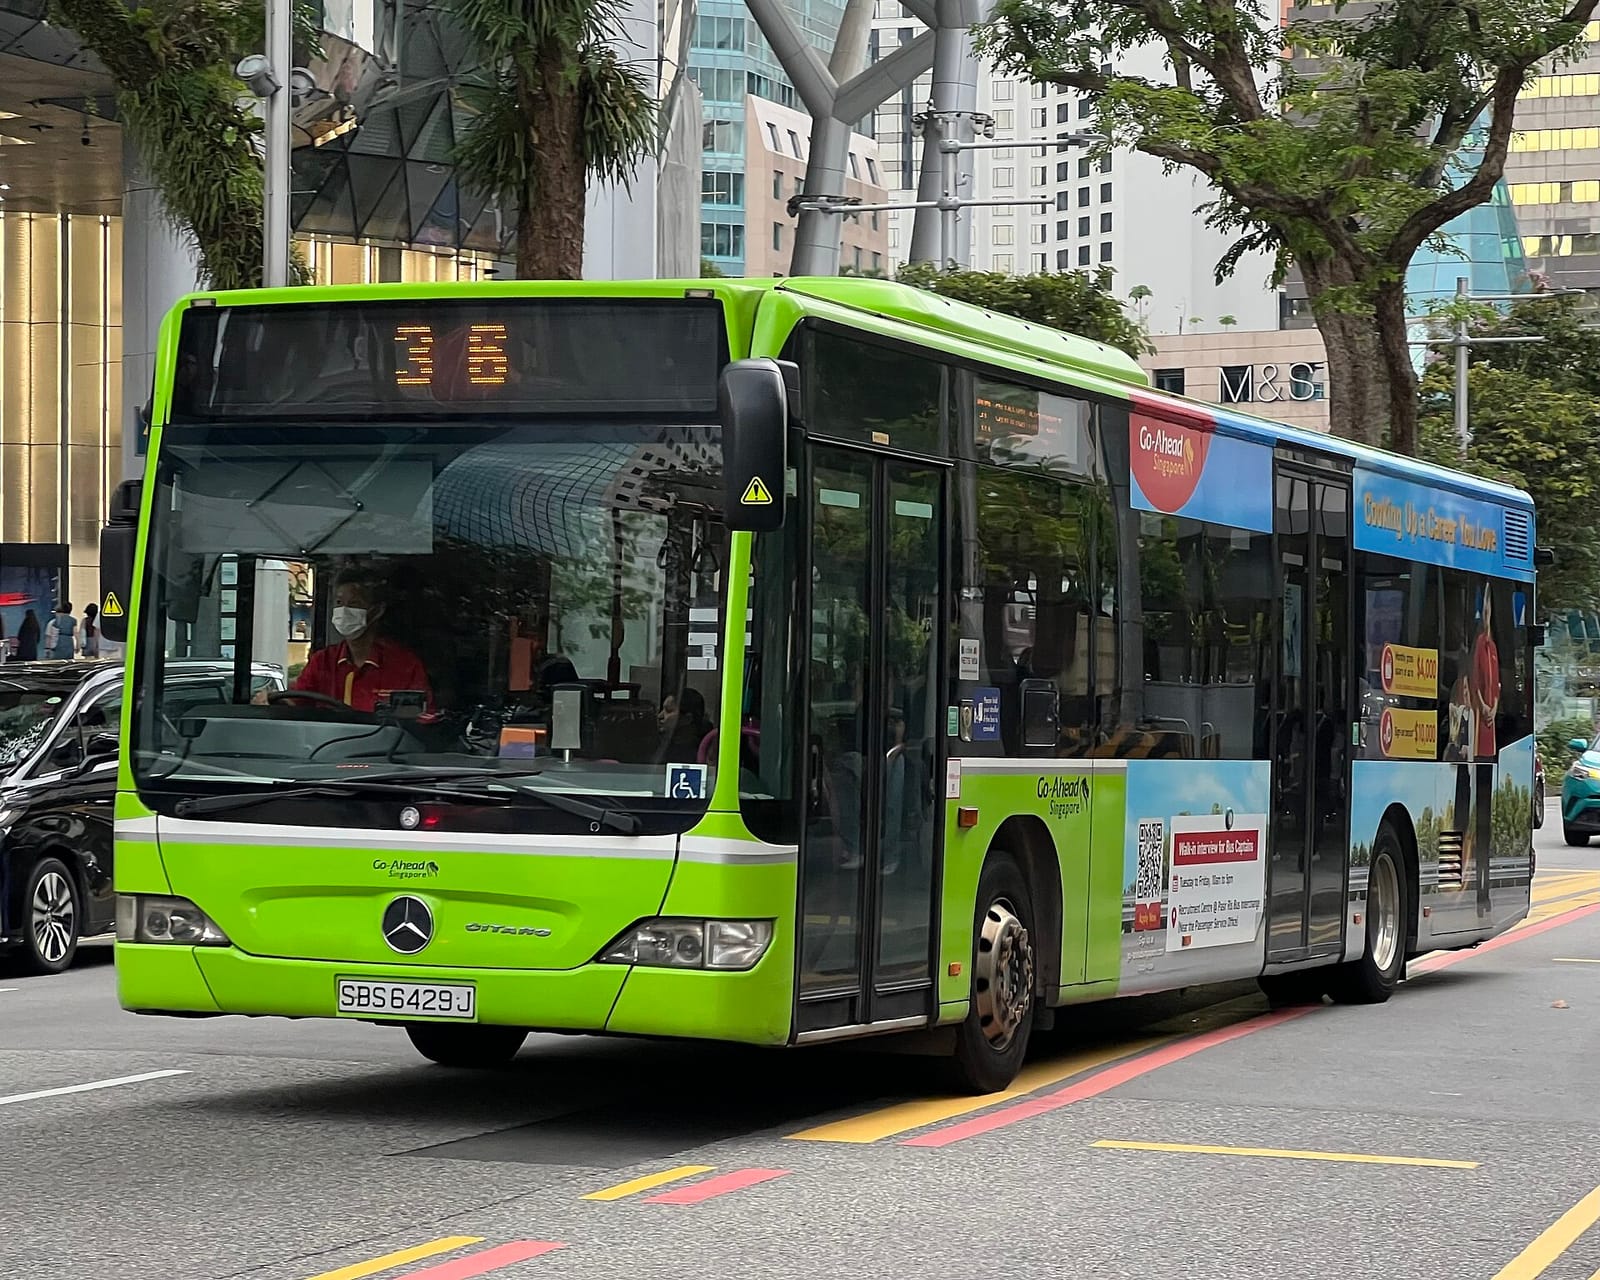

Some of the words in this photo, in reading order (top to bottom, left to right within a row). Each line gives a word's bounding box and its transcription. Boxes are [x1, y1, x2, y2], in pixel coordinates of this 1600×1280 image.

[1218, 362, 1315, 403] M&S
[1139, 425, 1184, 456] Go-Ahead
[1153, 455, 1185, 480] Singapore
[1364, 492, 1402, 541] Cooking
[1405, 500, 1418, 544] Up
[1420, 514, 1426, 538] a
[1428, 506, 1457, 545] Career
[1459, 513, 1475, 549] You
[1037, 776, 1080, 799] Go-Ahead
[1050, 800, 1080, 820] Singapore
[373, 859, 425, 871] Go-Ahead
[388, 870, 427, 879] Singapore
[465, 922, 552, 938] CITARO
